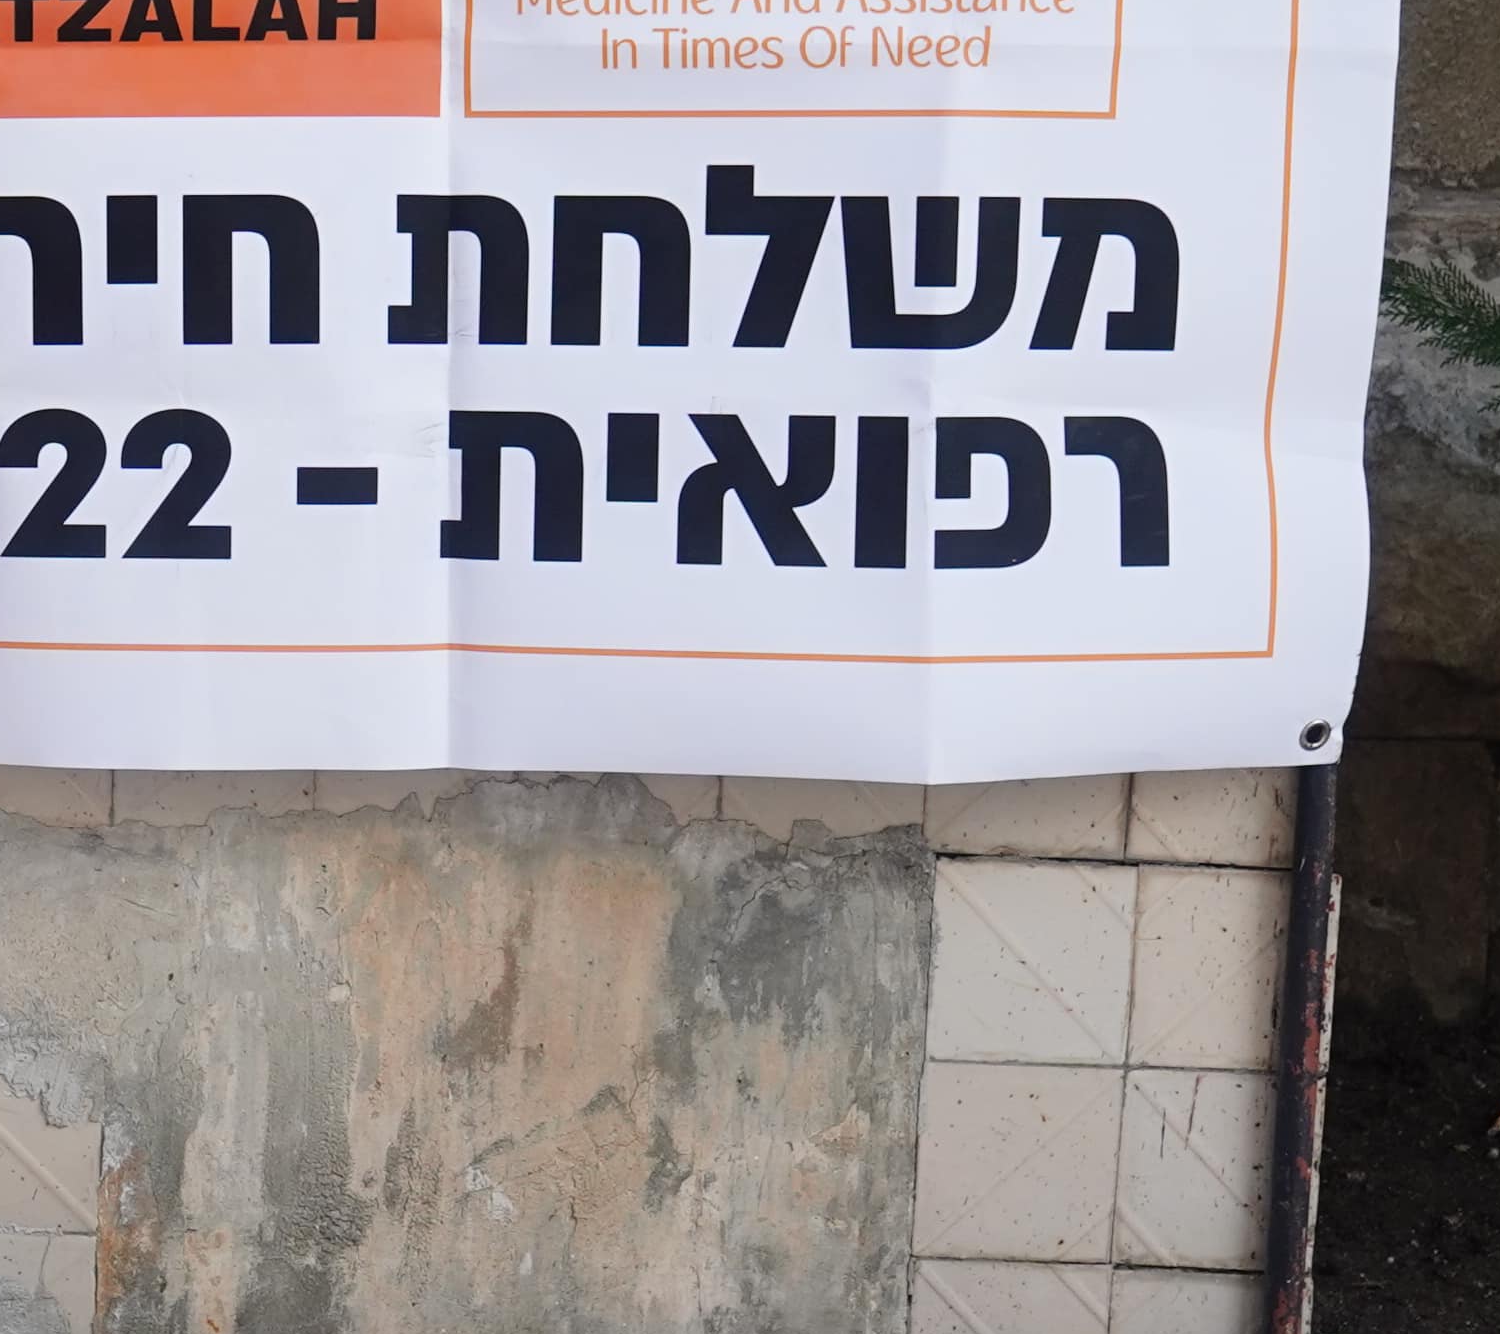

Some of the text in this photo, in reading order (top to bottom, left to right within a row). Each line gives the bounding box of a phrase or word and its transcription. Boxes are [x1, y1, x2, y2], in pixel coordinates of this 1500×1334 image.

[601, 26, 992, 69] In Times Of Need
[387, 164, 1180, 352] משלחת
[440, 410, 1171, 569] רפואית
